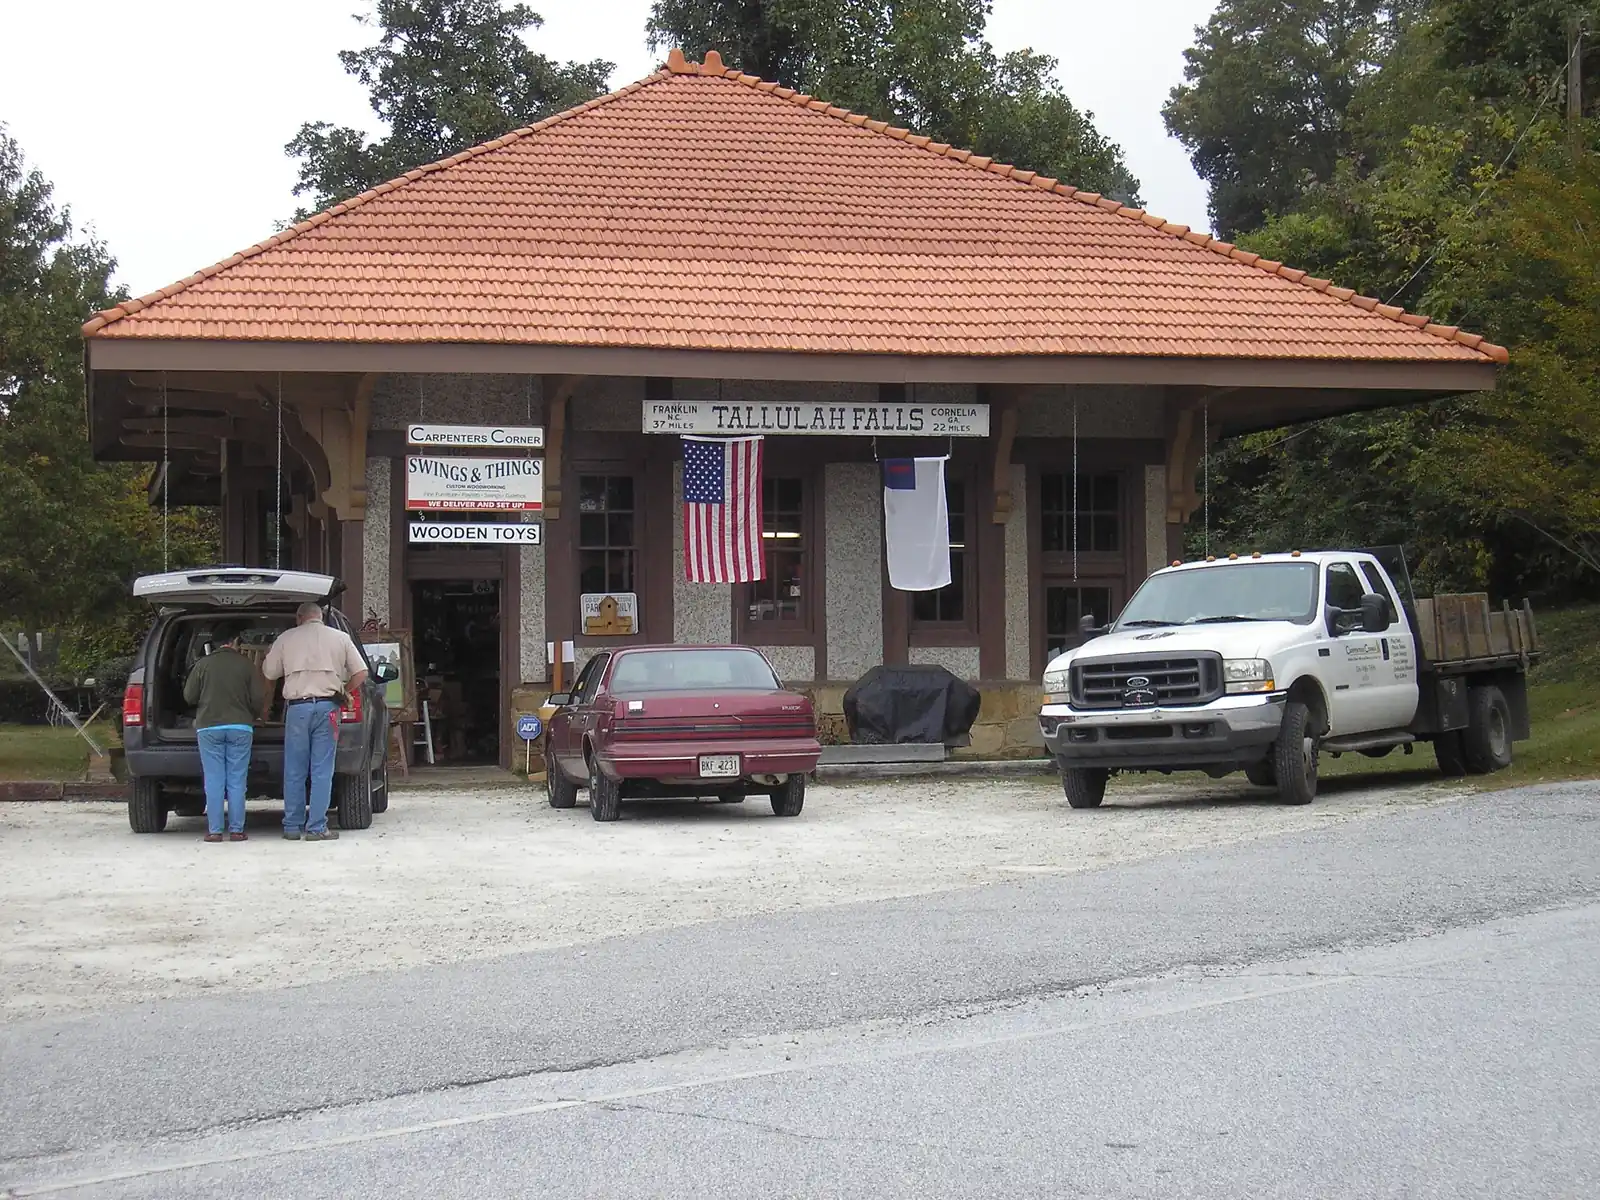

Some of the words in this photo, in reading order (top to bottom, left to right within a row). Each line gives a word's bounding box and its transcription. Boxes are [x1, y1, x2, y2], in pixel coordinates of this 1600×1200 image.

[652, 405, 698, 414] FRANKLIN
[931, 408, 977, 417] CORNELIA
[712, 405, 846, 429] TALLULAH
[852, 407, 924, 431] FALLS
[653, 421, 666, 429] 37
[410, 427, 488, 443] CARPENTERS
[491, 429, 541, 444] CORNER
[409, 457, 468, 482] SWINGS
[470, 467, 482, 483] &
[484, 460, 540, 480] THINGS
[412, 526, 488, 539] WOODEN
[493, 527, 537, 540] TOYS
[520, 723, 538, 732] ADT
